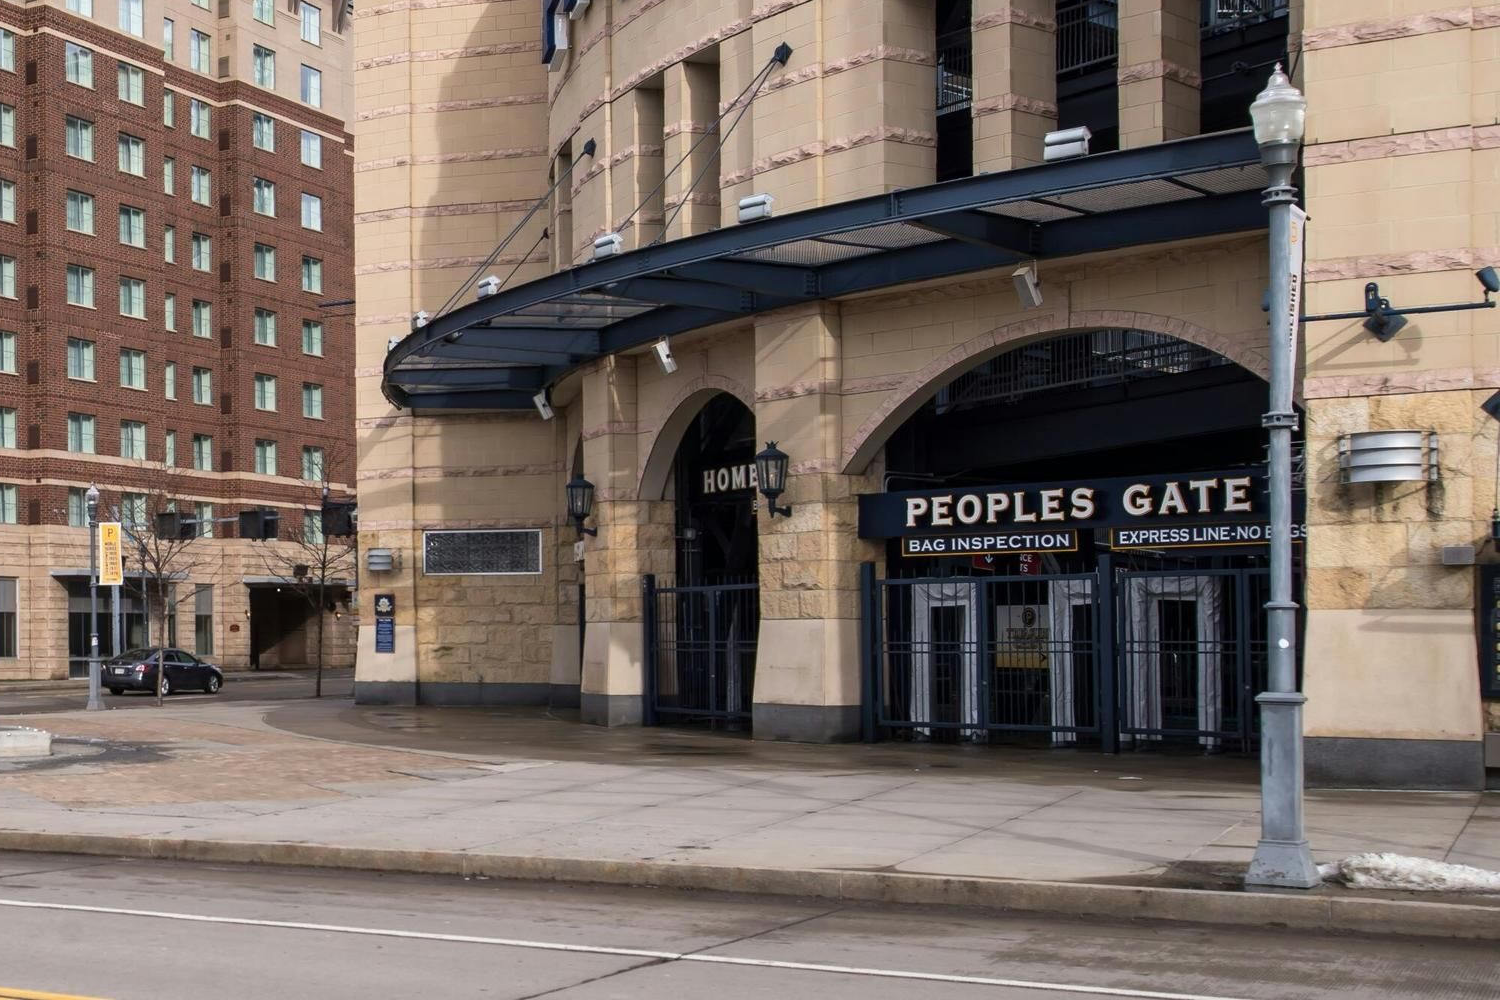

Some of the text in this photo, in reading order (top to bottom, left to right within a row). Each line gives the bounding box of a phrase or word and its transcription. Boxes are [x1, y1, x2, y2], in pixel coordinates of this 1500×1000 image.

[906, 476, 1252, 527] PEOPLES GATE
[909, 533, 1070, 552] BAG INSPECTION
[1119, 523, 1308, 545] EXPRESS LINE-NO BGS
